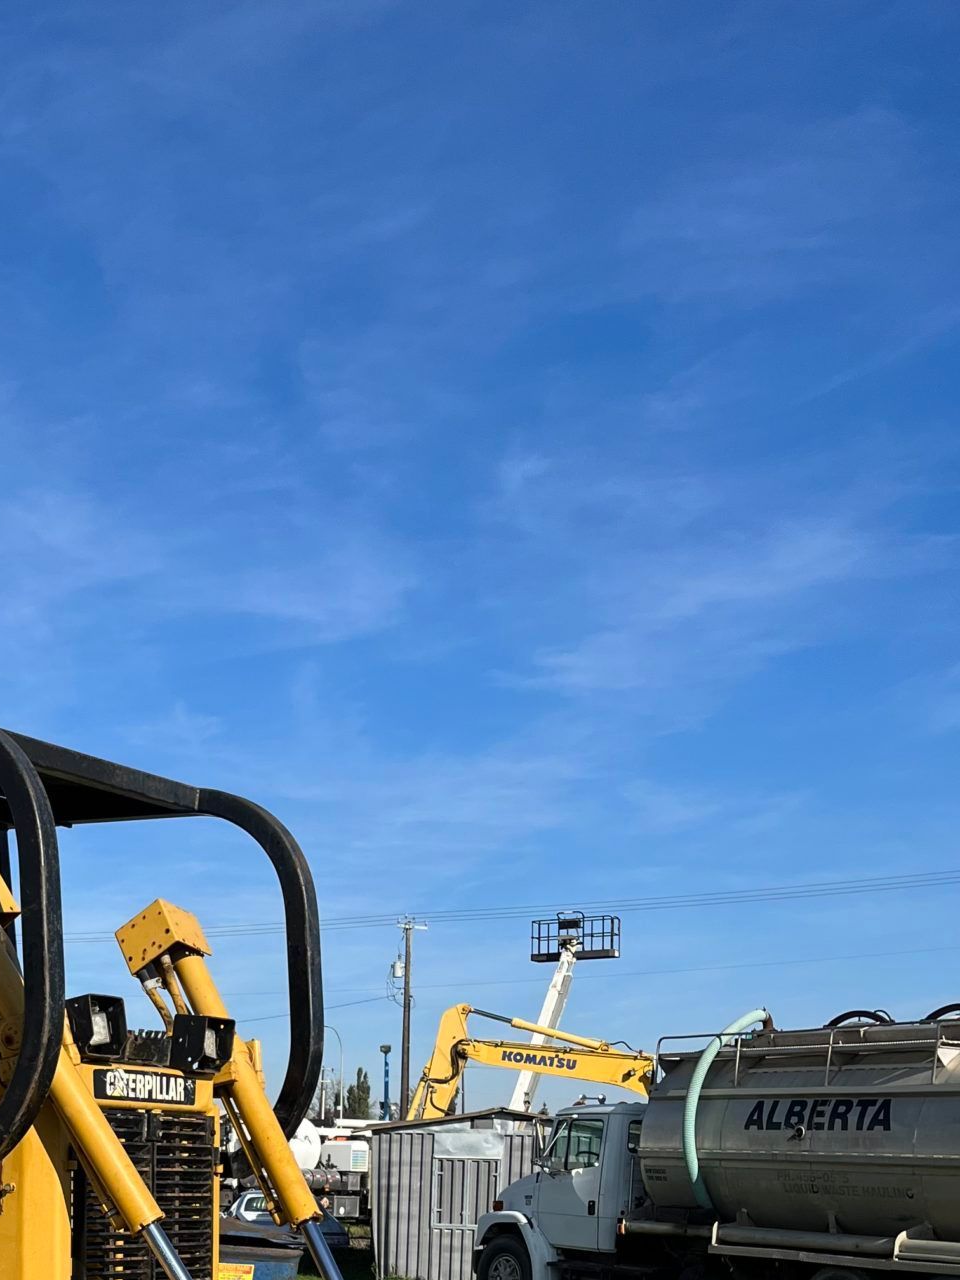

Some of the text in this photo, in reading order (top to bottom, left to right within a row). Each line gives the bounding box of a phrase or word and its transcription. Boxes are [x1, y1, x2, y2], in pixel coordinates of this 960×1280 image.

[501, 1050, 577, 1070] KOMATSU
[106, 1069, 185, 1102] CATERPILLAR
[744, 1099, 892, 1132] ALBERTA
